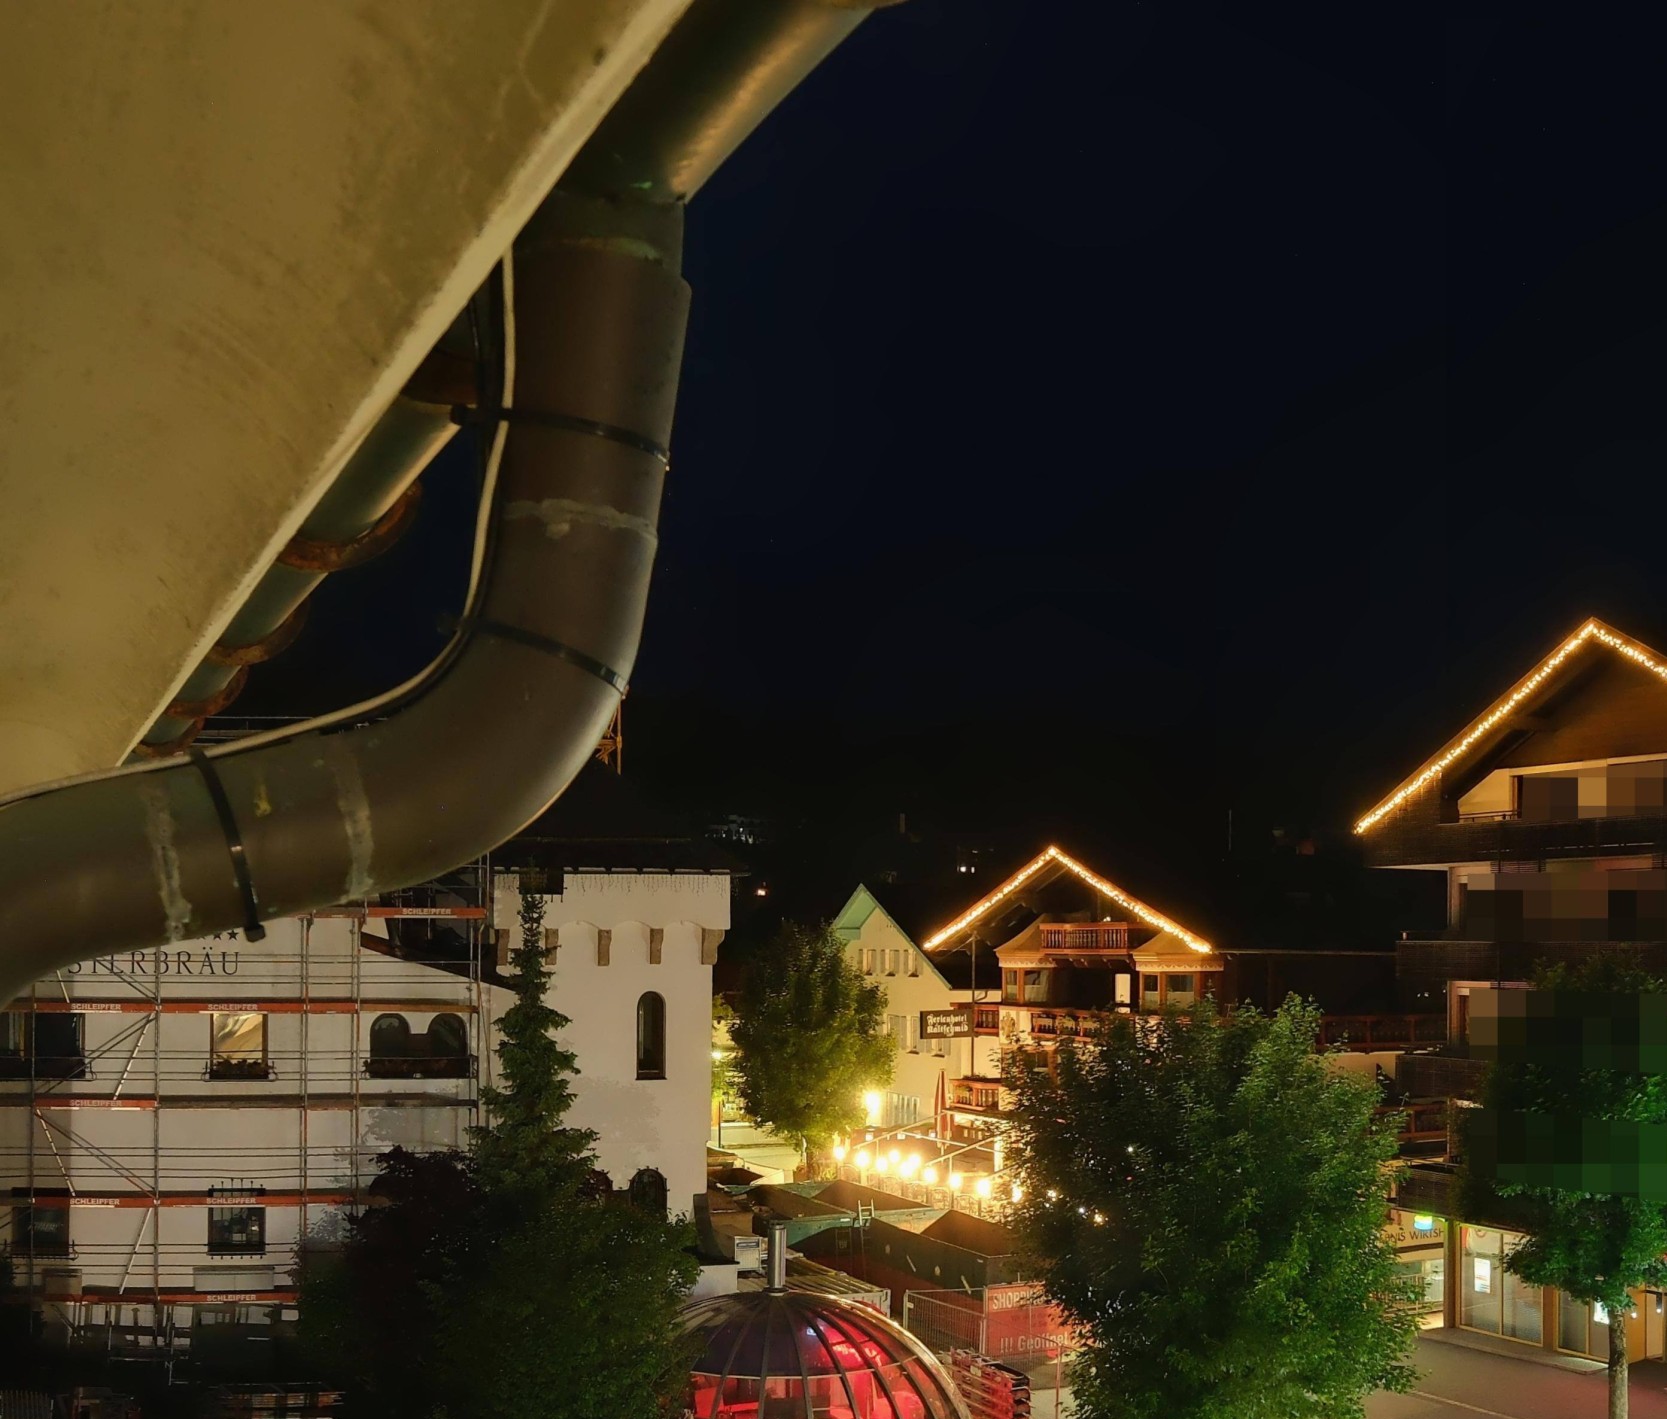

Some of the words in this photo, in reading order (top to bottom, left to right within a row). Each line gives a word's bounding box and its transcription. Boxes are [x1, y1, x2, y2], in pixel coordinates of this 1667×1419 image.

[402, 907, 452, 916] SCHLEIPFER
[67, 946, 240, 976] STERBRÄU
[71, 1003, 122, 1011] SCHLEIPFER
[207, 1003, 259, 1011] SCHLEIPFER
[69, 1198, 120, 1206] SCHLEIPFER
[206, 1197, 257, 1205] SCHLEIPFER
[206, 1294, 257, 1302] SCHLEIPFER
